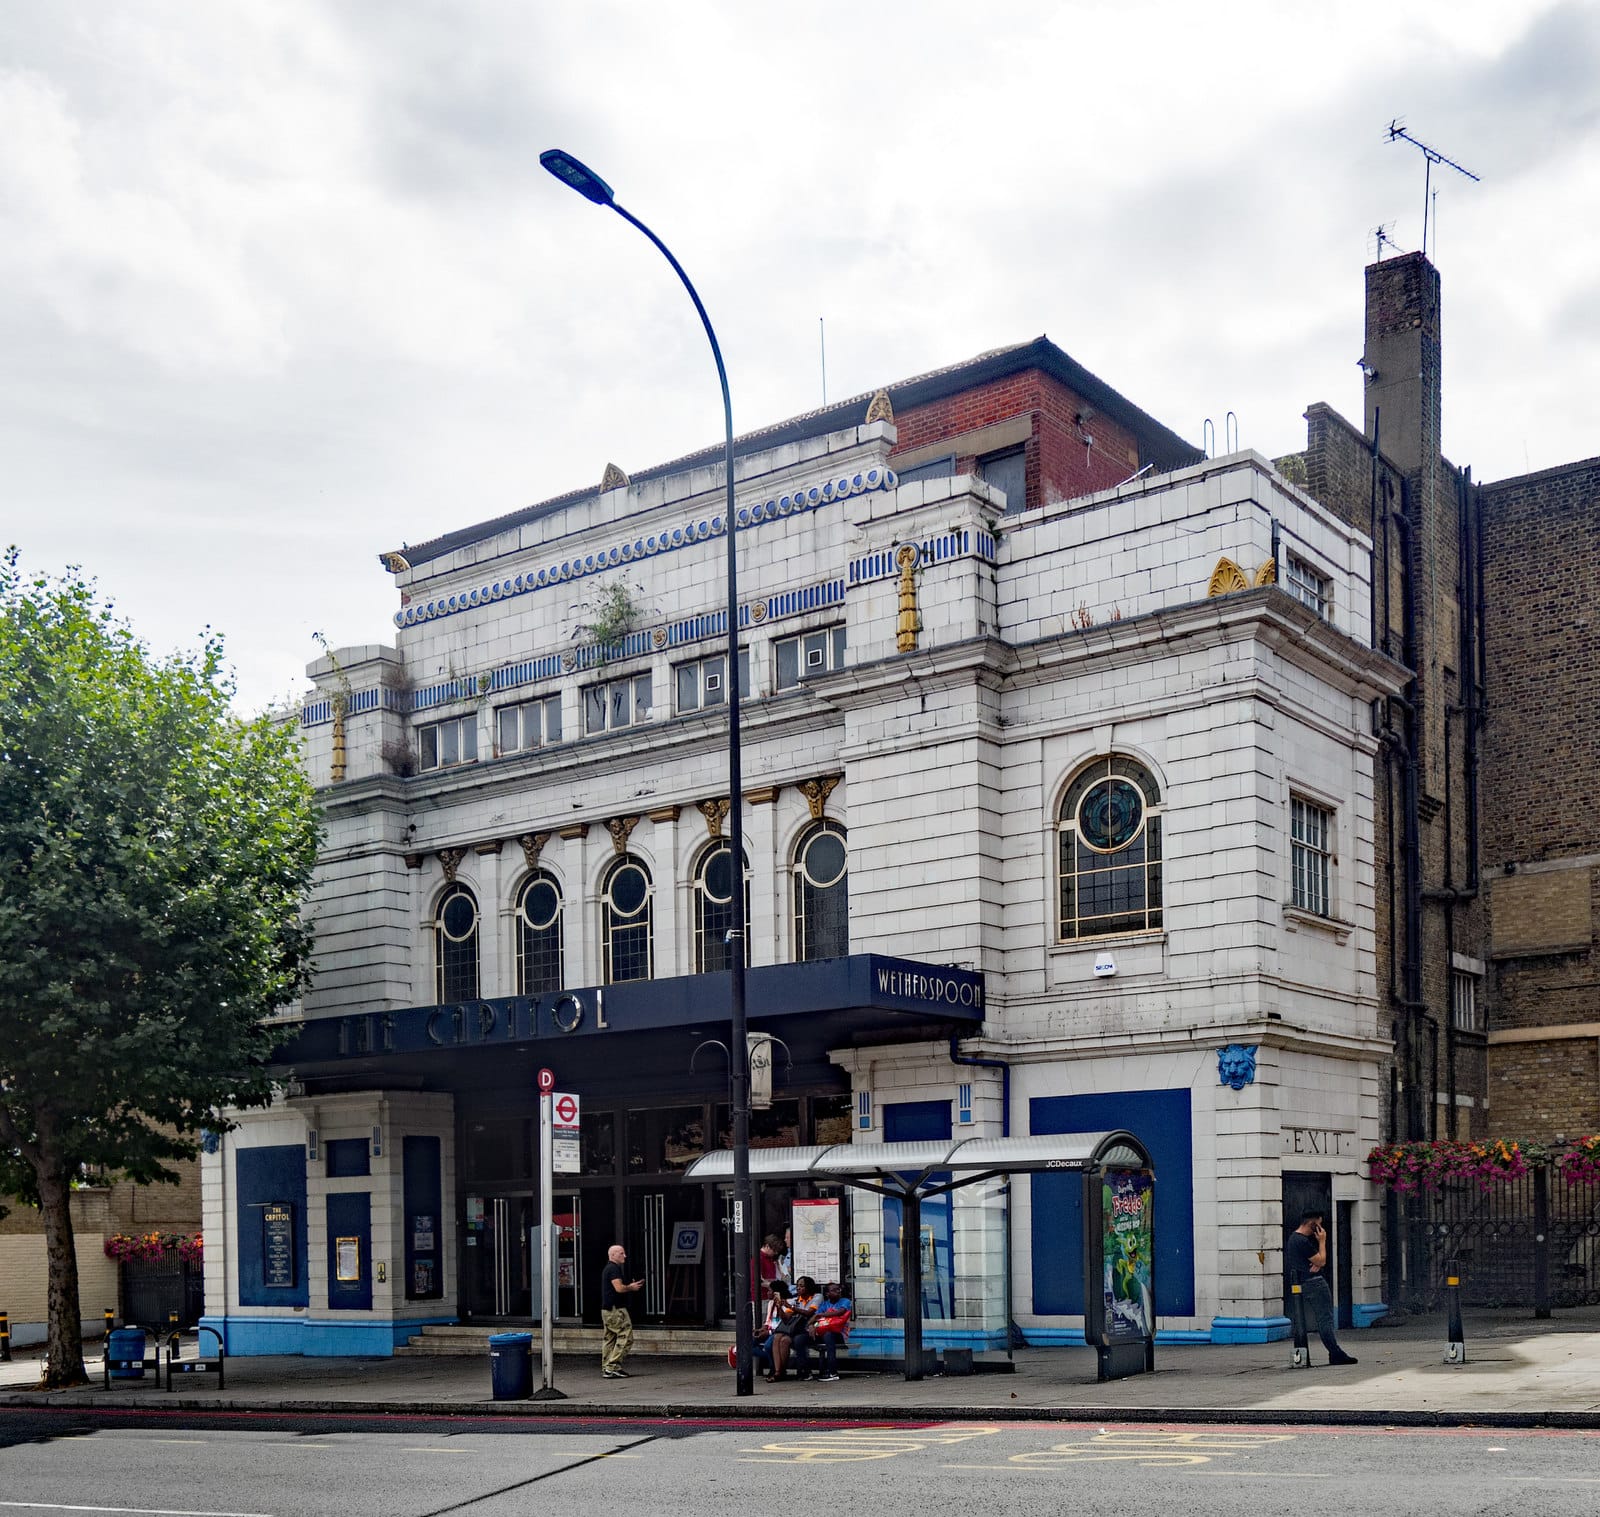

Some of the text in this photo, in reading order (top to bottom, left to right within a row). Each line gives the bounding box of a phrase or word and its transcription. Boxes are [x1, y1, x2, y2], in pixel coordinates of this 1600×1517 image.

[877, 968, 981, 1007] WETHERSPOON
[427, 989, 608, 1045] CAPITOL
[541, 1072, 552, 1086] D
[1294, 1130, 1342, 1155] EXIT
[1046, 1160, 1083, 1168] JCDecaux
[265, 1213, 289, 1221] CAPITOL
[1112, 1195, 1142, 1217] Freddo
[735, 1426, 1002, 1464] STOP
[1008, 1431, 1297, 1467] BUS
